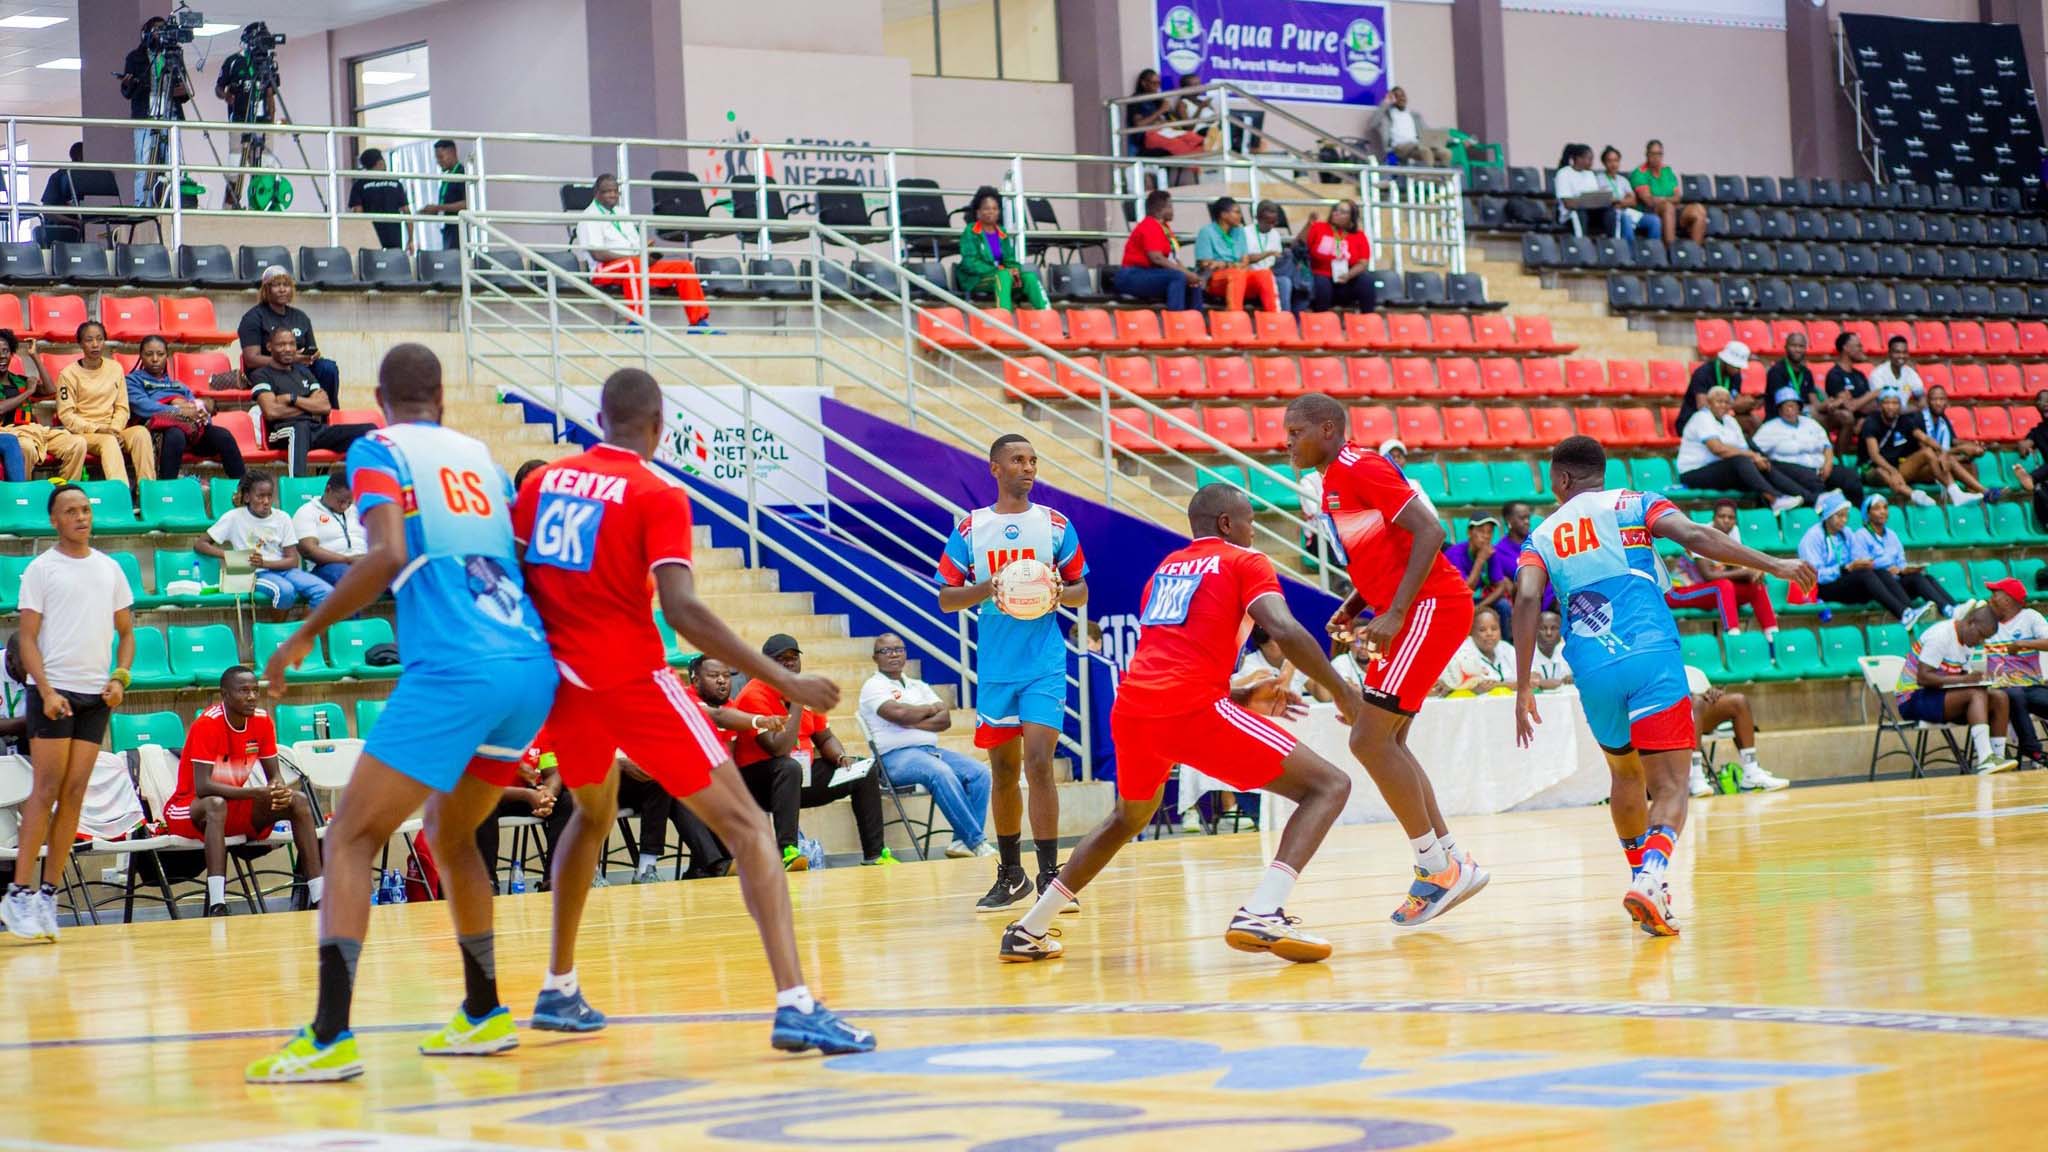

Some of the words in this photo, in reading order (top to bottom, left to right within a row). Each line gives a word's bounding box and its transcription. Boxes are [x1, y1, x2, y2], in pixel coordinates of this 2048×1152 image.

[1208, 19, 1272, 50] Aqua
[1281, 23, 1339, 53] Pure
[1210, 56, 1231, 70] The
[1232, 57, 1265, 72] Purest
[1266, 59, 1297, 74] Water
[1297, 61, 1340, 77] Possible
[782, 138, 875, 163] AFRICA
[785, 193, 820, 216] CU
[713, 427, 775, 443] AFRCA
[439, 466, 492, 517] GS
[539, 467, 628, 505] KENYA
[535, 498, 596, 565] GK
[1552, 516, 1601, 560] GA
[1149, 576, 1194, 620] WD
